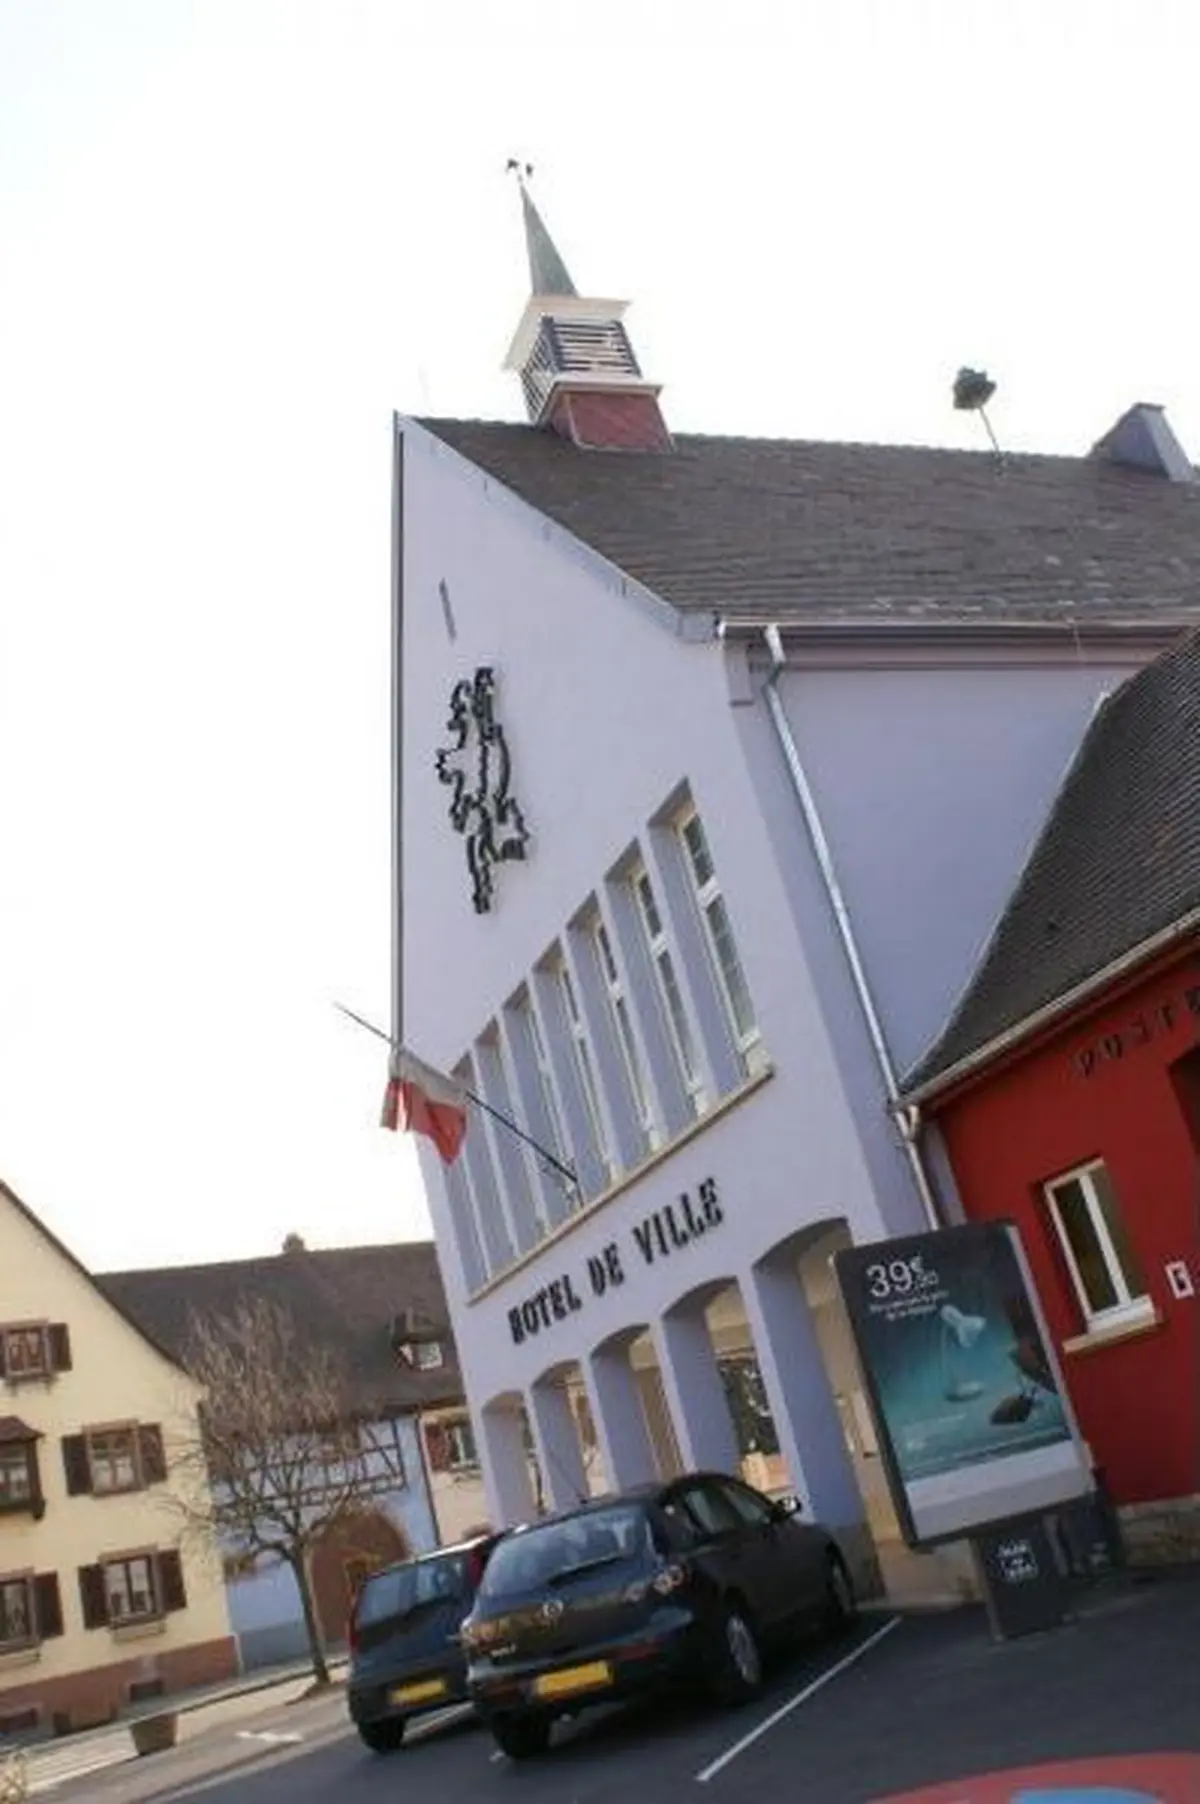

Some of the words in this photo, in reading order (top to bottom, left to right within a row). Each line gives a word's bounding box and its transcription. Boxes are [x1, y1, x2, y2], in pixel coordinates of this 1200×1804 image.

[508, 1274, 583, 1345] HOTEL
[587, 1242, 625, 1296] DE
[633, 1177, 723, 1265] VILLE
